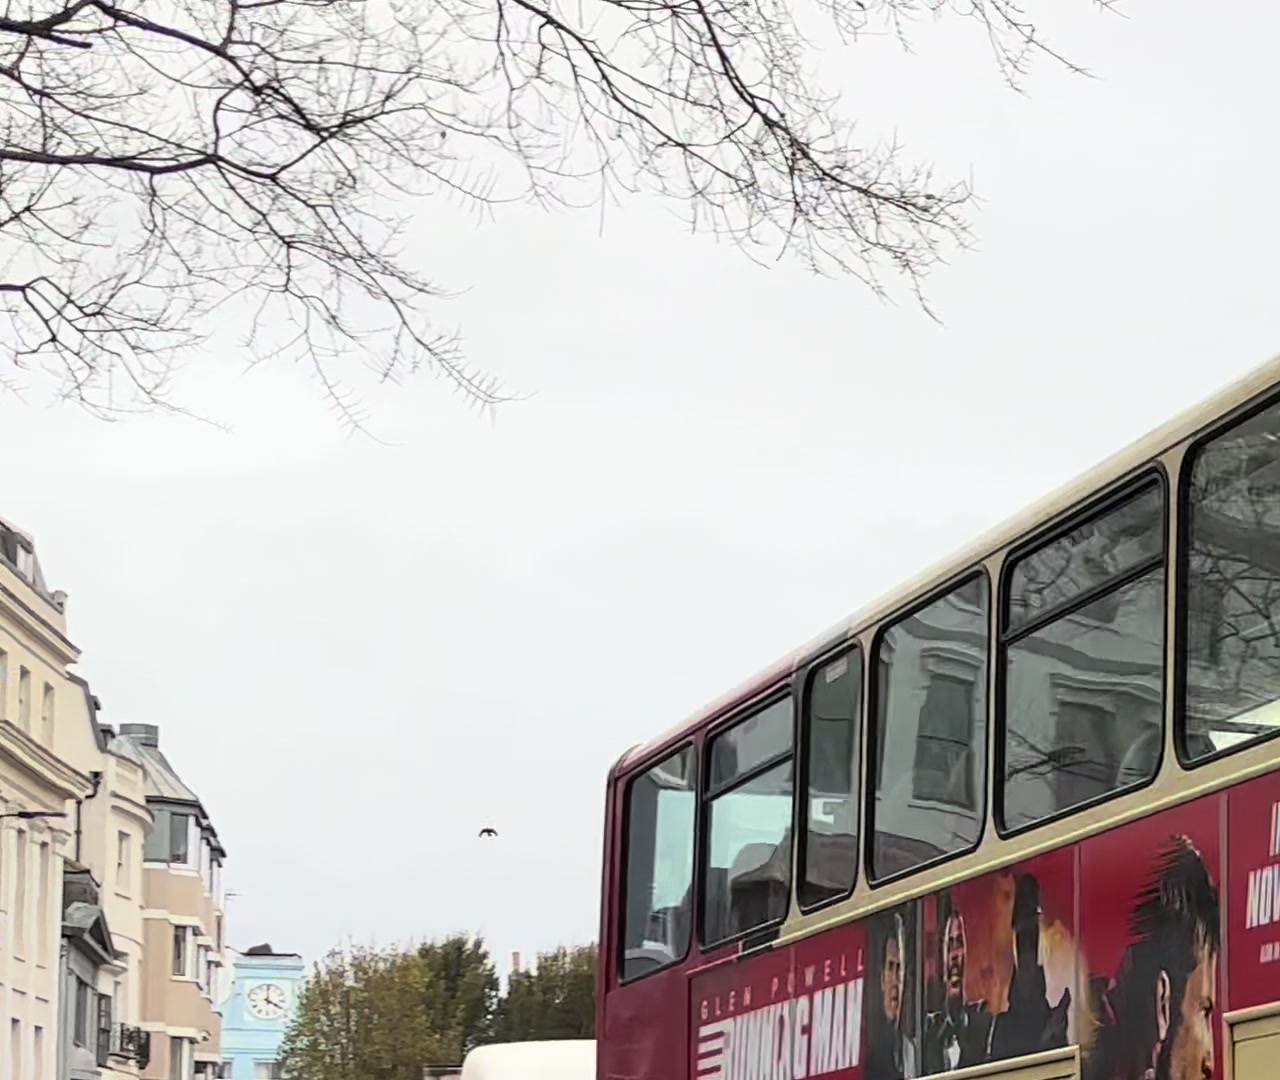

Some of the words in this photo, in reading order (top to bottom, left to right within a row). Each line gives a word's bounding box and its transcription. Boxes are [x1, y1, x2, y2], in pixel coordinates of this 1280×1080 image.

[701, 985, 751, 1020] GLEN
[771, 949, 864, 1000] POWELL
[808, 977, 864, 1077] MAN
